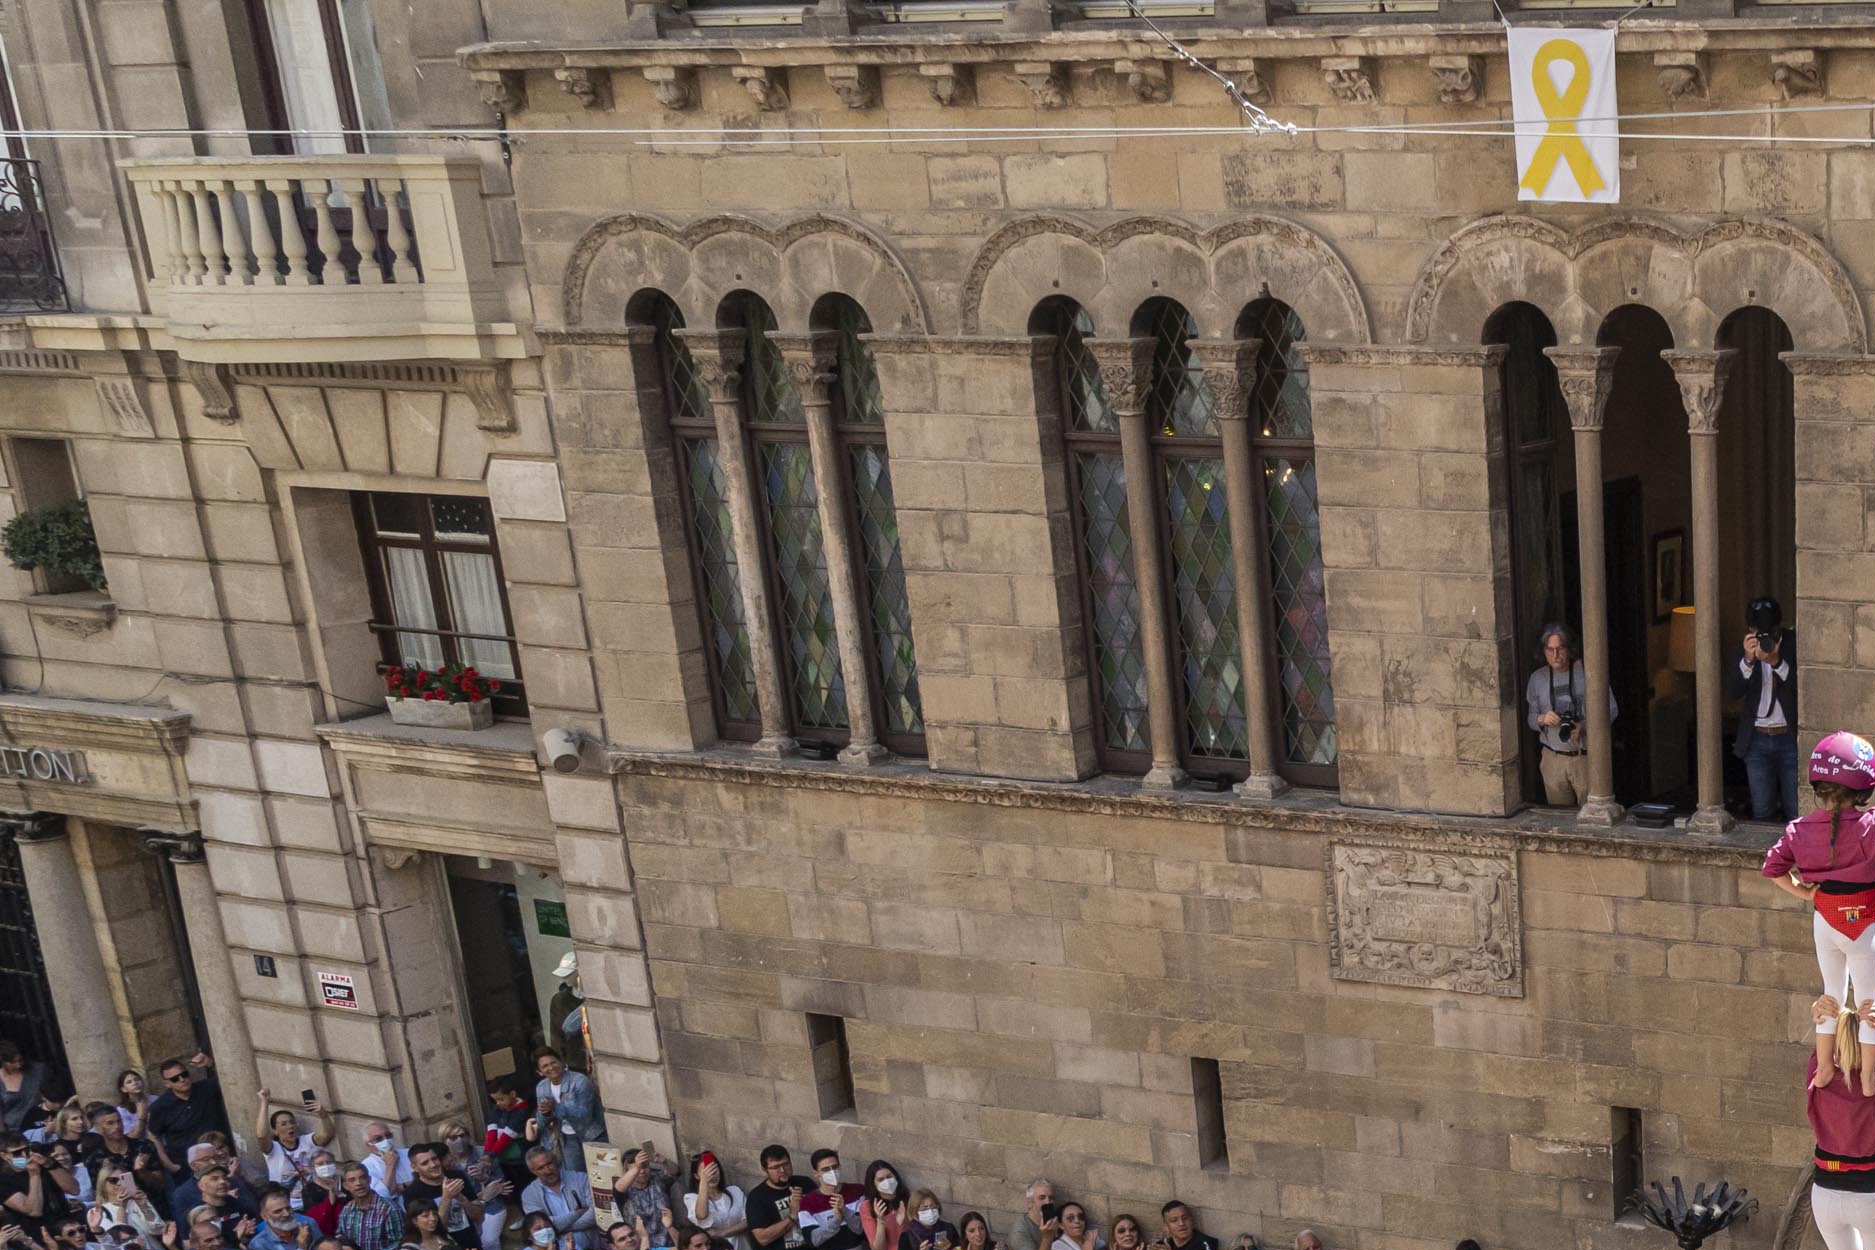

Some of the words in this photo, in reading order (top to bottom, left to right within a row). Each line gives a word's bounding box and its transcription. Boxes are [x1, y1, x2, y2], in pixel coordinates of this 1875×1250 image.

[1813, 764, 1829, 775] Ares
[1828, 755, 1840, 764] de
[1842, 759, 1875, 778] Lleida
[321, 973, 351, 983] ALARMA
